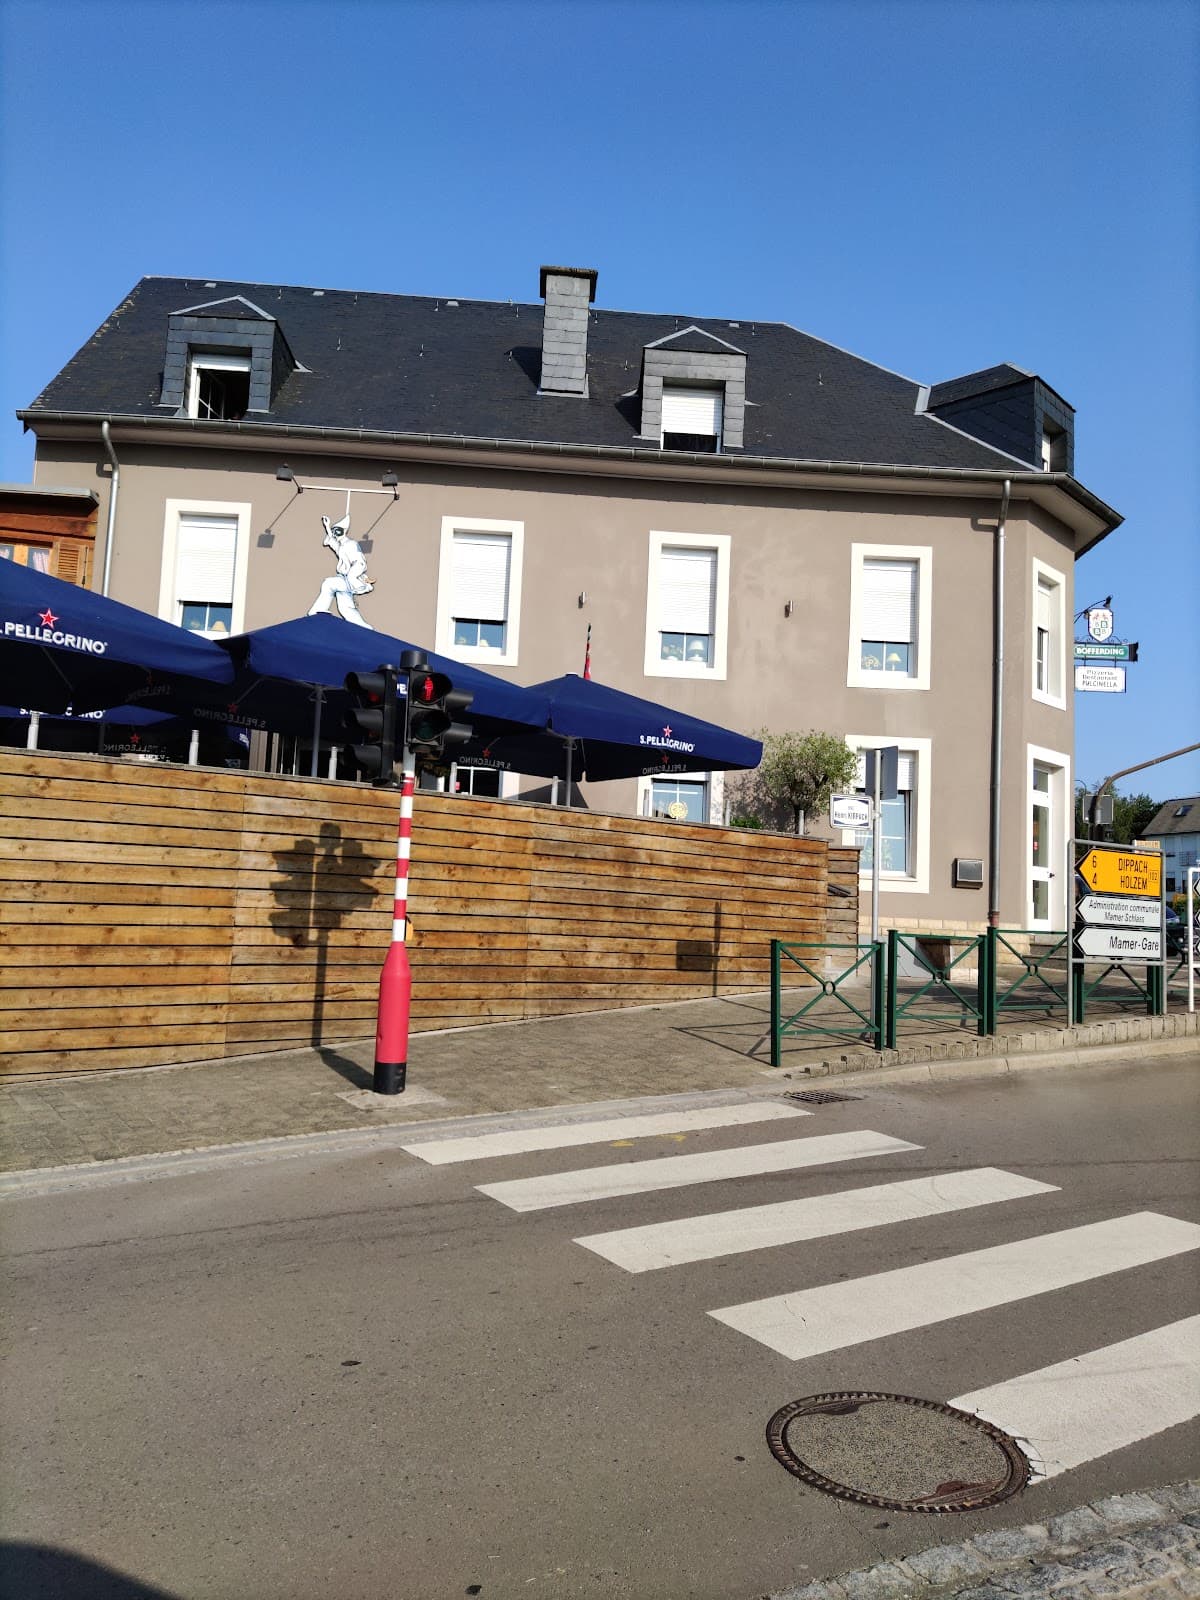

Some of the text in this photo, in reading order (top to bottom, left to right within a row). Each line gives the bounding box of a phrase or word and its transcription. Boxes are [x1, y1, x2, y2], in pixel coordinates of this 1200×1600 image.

[0, 622, 107, 654] .PELLEGRINO
[1076, 647, 1124, 655] BOFFERDING
[1082, 680, 1118, 688] PULCINELLA
[1092, 855, 1148, 873] 6 DIPPACH
[1092, 873, 1097, 885] 4
[1120, 875, 1148, 890] HOLZEM
[1089, 899, 1160, 914] Administration communale
[1104, 912, 1124, 922] Mamer
[1109, 936, 1160, 951] Mamer-Gare
